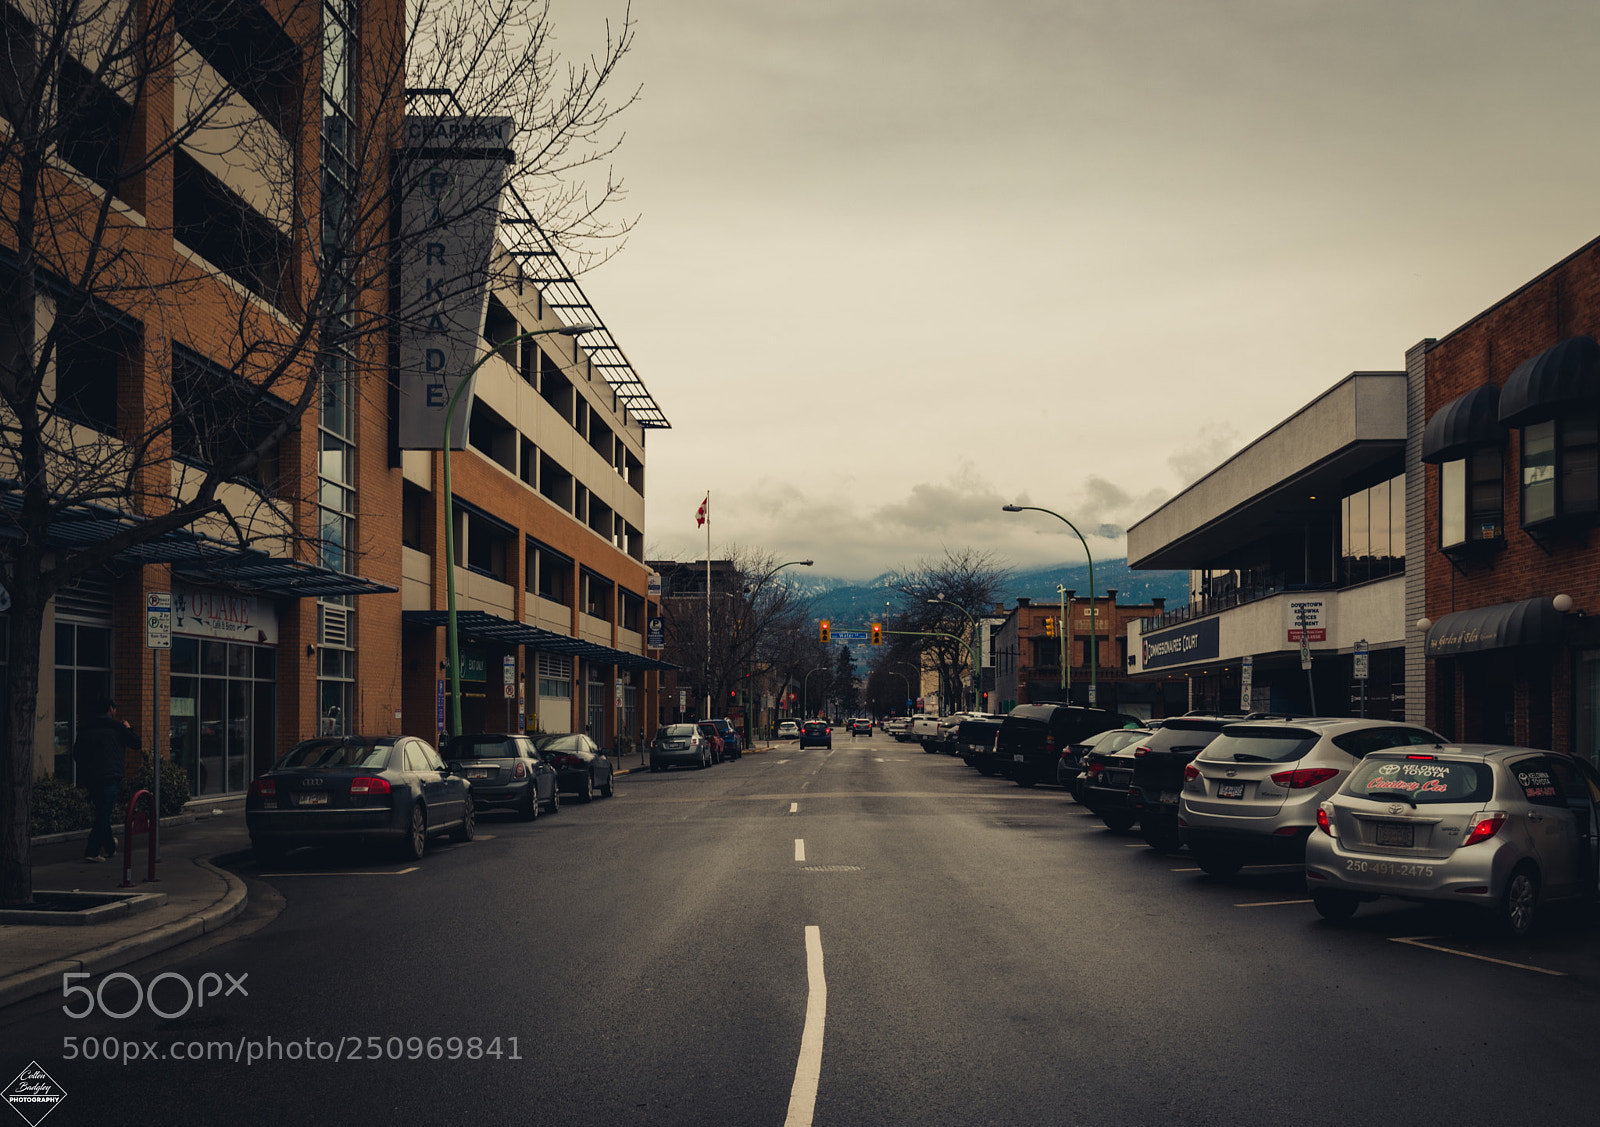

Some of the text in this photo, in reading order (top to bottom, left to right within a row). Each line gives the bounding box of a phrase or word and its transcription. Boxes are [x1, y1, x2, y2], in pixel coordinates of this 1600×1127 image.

[1183, 633, 1199, 653] COURT
[1402, 764, 1450, 774] KELOWNA
[1404, 769, 1445, 778] TOYOTA
[1367, 777, 1447, 792] Courtesy Car
[1346, 859, 1434, 877] 250-491-2475
